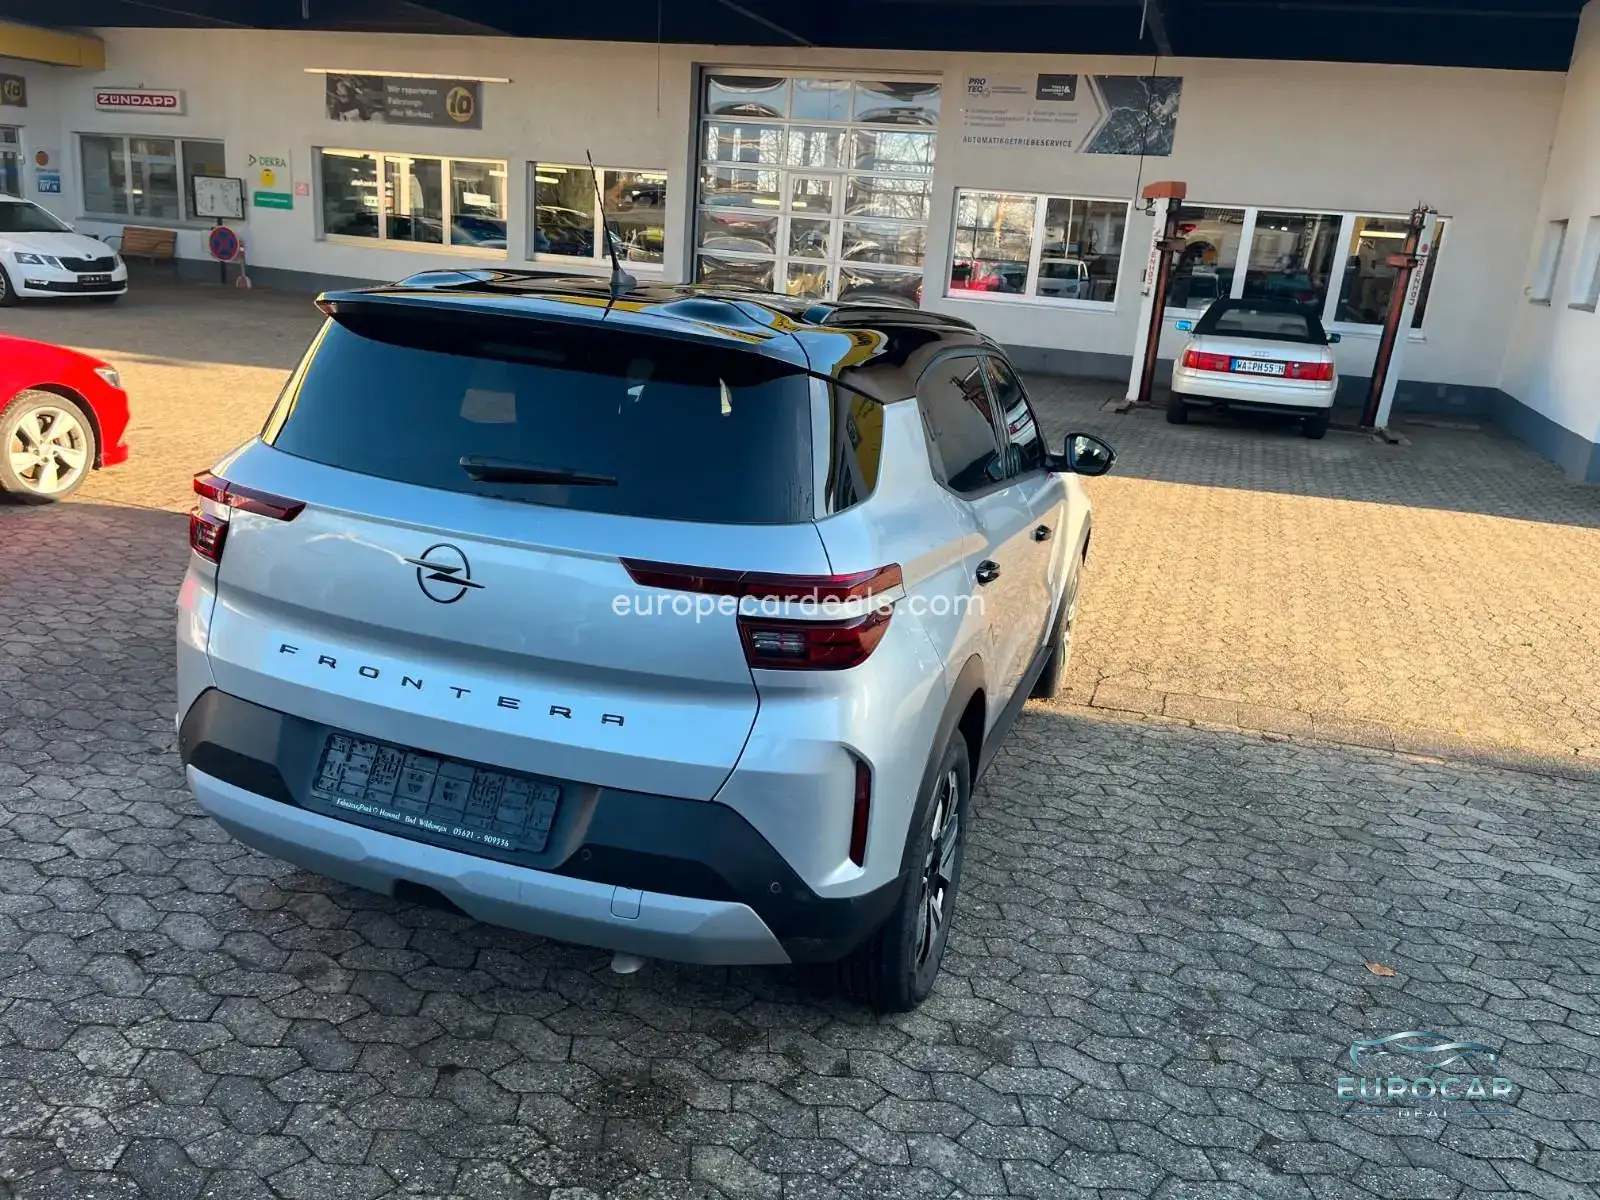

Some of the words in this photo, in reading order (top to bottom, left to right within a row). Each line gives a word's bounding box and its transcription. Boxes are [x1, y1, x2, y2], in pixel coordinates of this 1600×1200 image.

[98, 94, 175, 107] ZÜNDAPP
[962, 135, 1073, 147] AUTOMATIKGETRIEBESERVICE
[258, 156, 287, 167] DEKRA
[279, 643, 625, 727] FRONTERA
[452, 827, 475, 839] 05621
